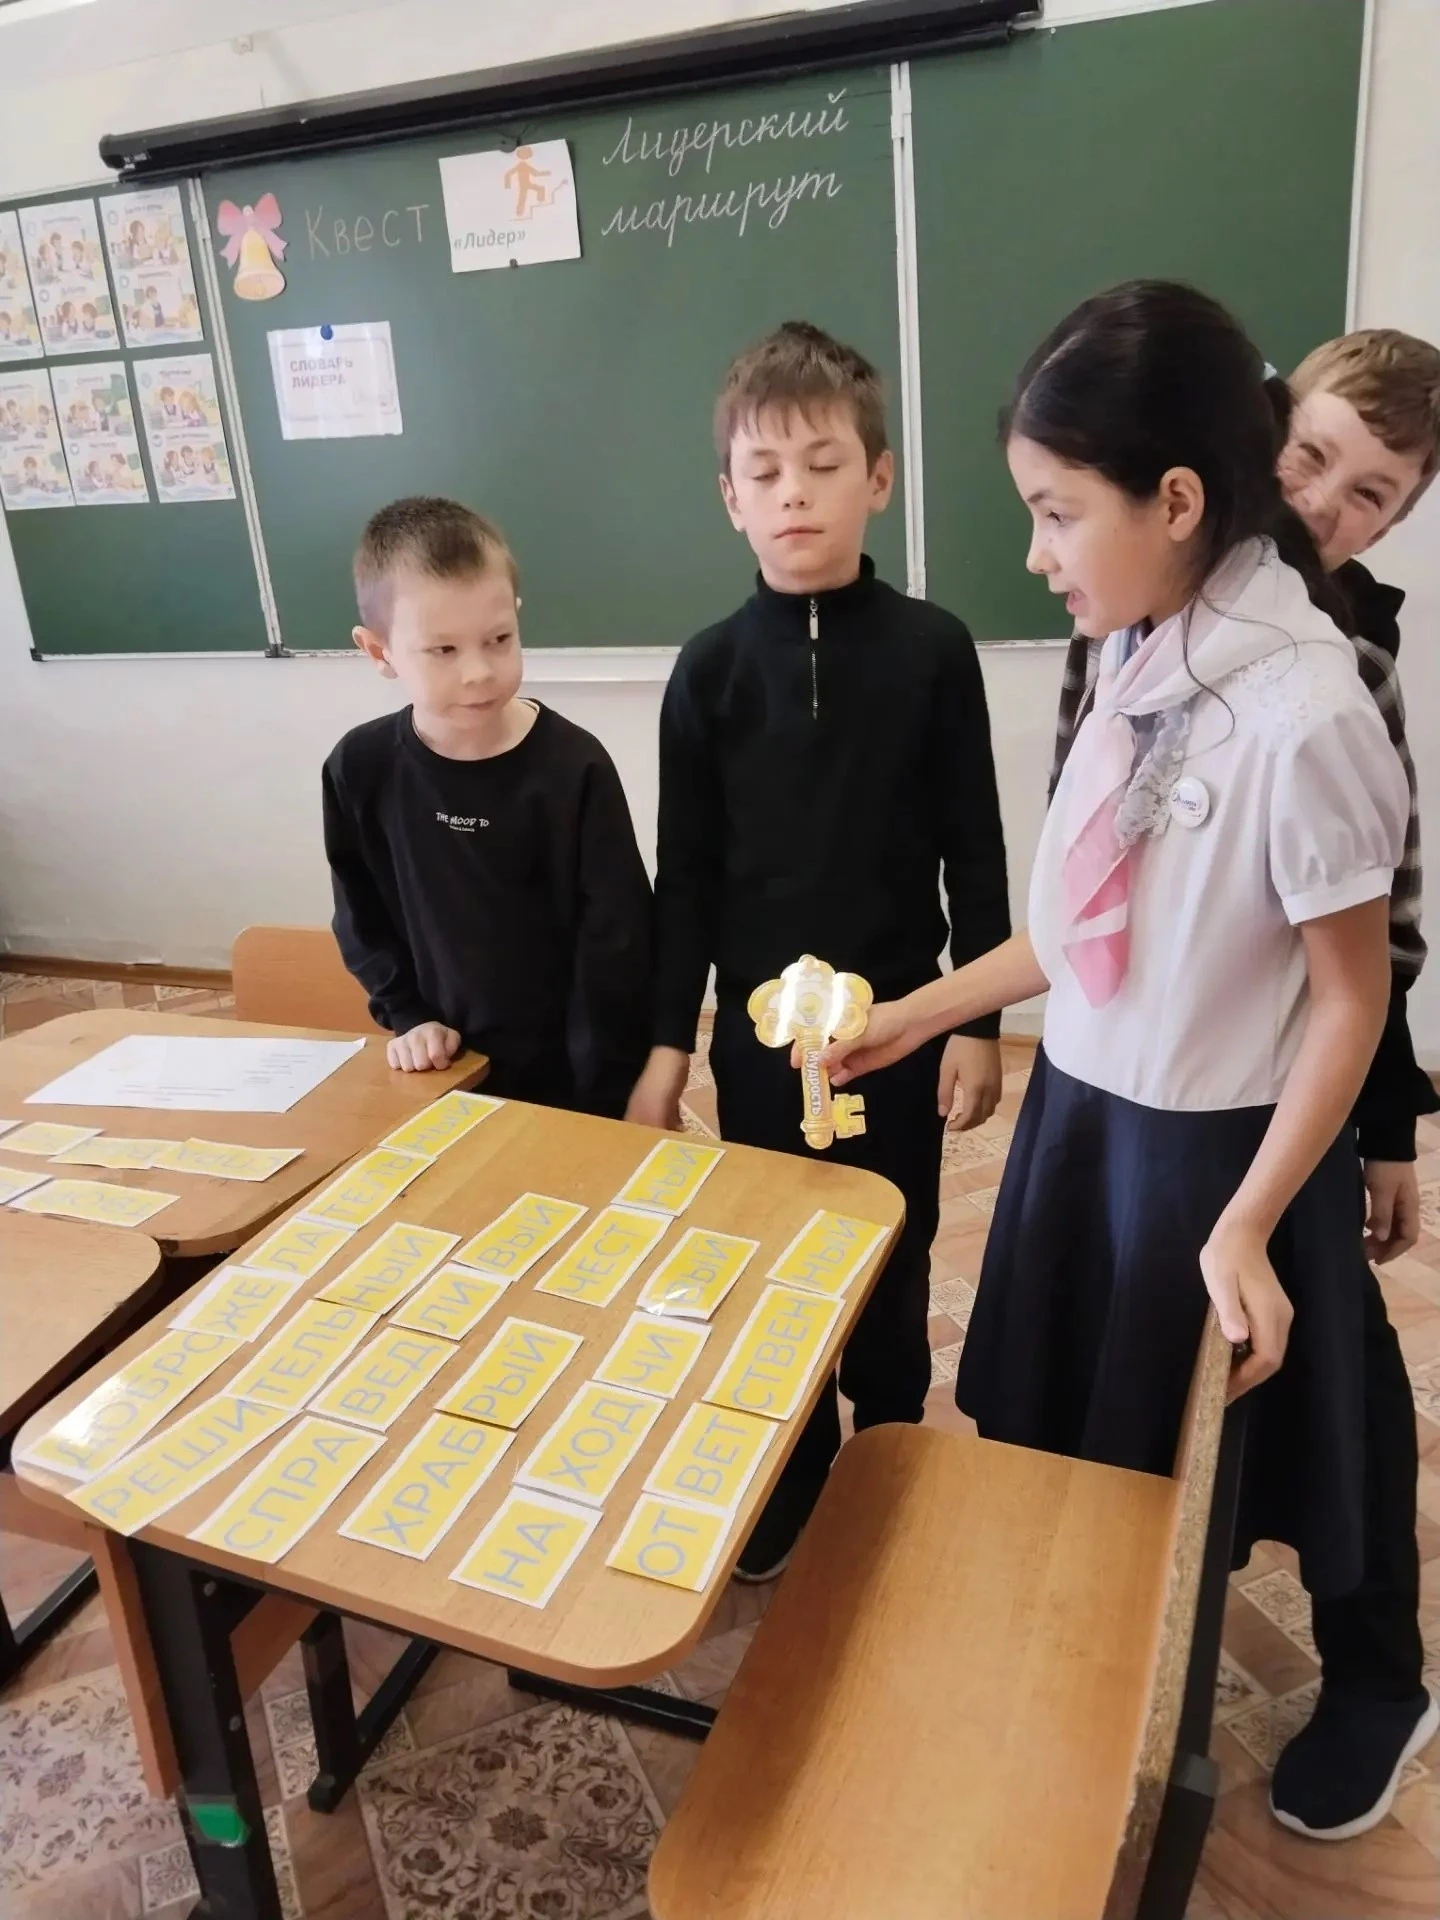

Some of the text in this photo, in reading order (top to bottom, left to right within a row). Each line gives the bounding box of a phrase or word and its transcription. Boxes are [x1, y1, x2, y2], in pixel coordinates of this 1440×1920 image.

[602, 88, 849, 176] Лидерский
[454, 229, 526, 249] «Лидер»
[601, 171, 843, 248] маршрут
[290, 357, 354, 372] СЛОВАРЬ
[292, 374, 347, 389] ЛИДЕРА
[436, 812, 490, 827] THE MOOD TO
[557, 1146, 709, 1294] ЧЕСТ НЫЙ
[57, 1331, 225, 1470] ДОБРО
[205, 1280, 276, 1332] ЖЕ
[269, 1229, 331, 1271] ЛА
[320, 1155, 413, 1218] ТЕЛЬ
[91, 1235, 434, 1519] РЕШИ ТЕЛЬ НЫЙ
[223, 1204, 565, 1550] СПРА ВЕД ЛИ ВЫЙ
[369, 1331, 557, 1546] ХРАБ РЫЙ
[483, 1238, 737, 1590] НА ХОД ЧИ ВЫЙ
[636, 1217, 868, 1577] ОТ ВЕТ СТВЕН НЫЙ
